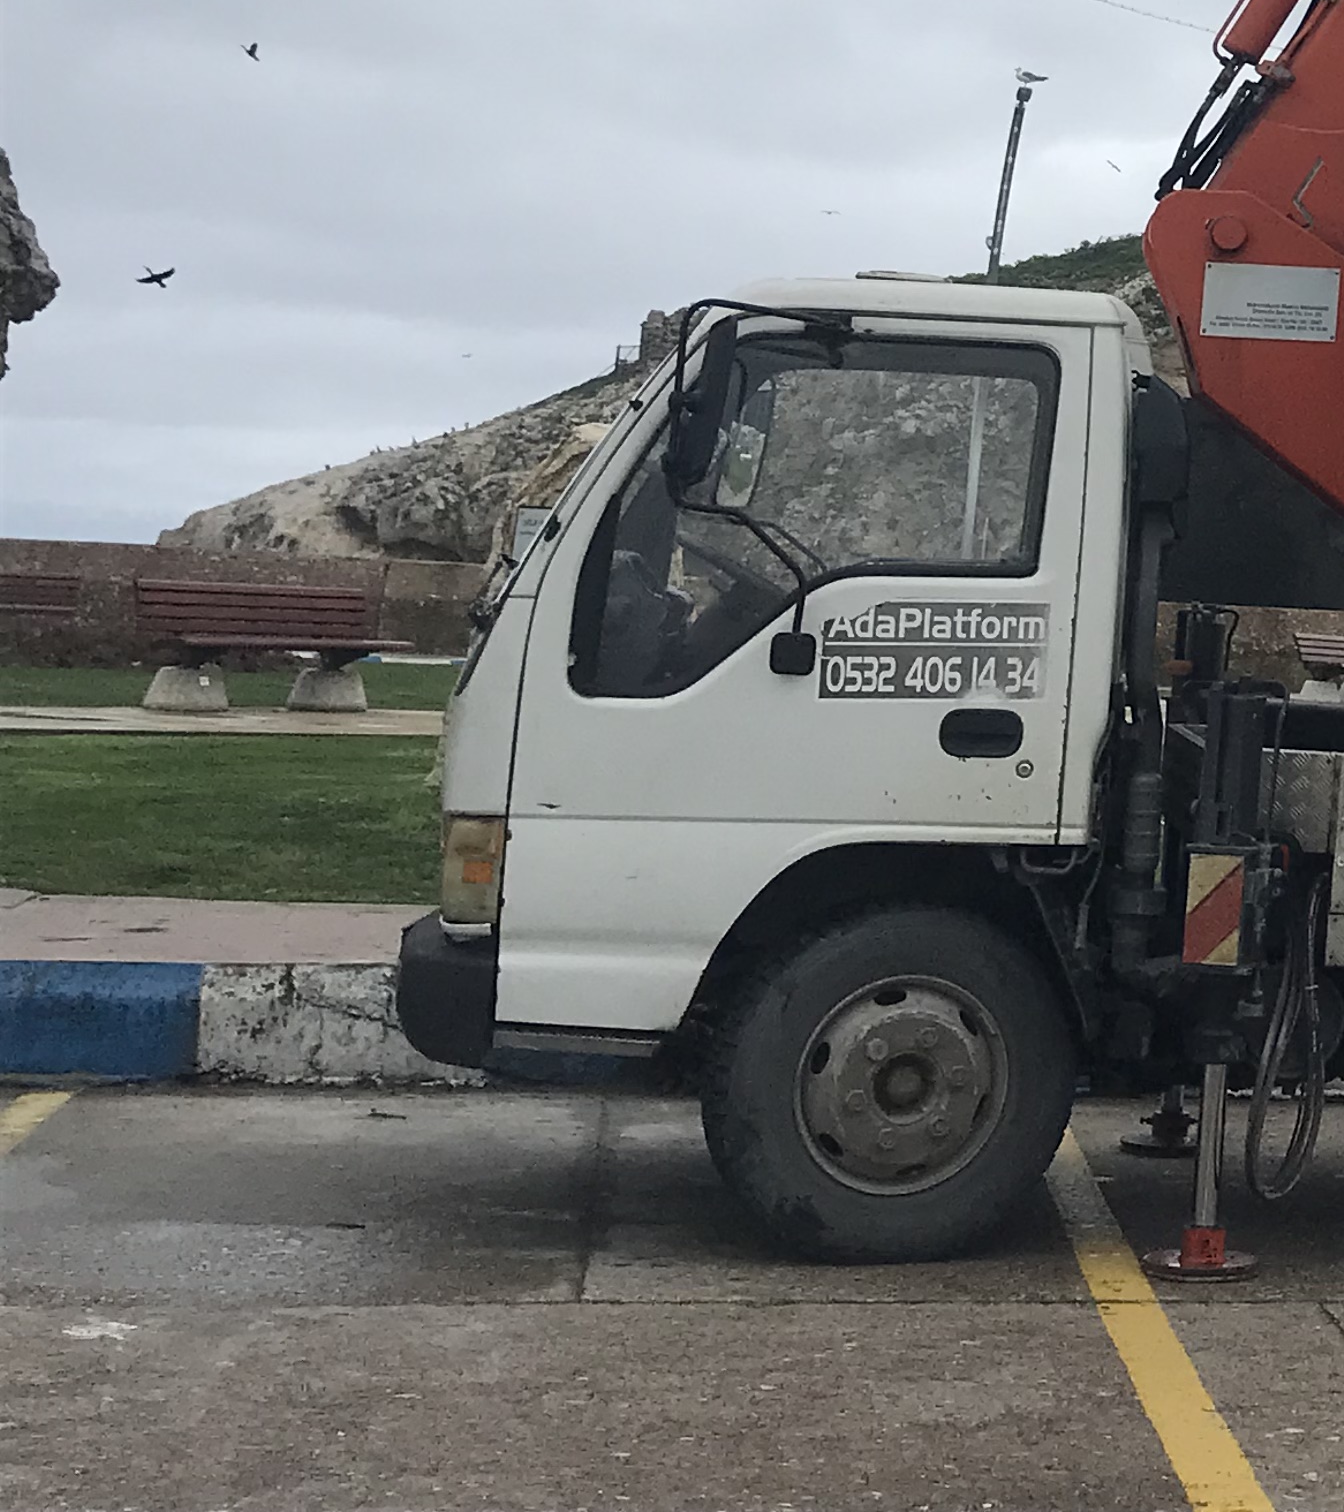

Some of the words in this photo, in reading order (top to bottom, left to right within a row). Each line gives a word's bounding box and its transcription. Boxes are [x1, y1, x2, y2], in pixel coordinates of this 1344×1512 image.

[828, 607, 1046, 639] AdaPlatform
[825, 655, 897, 693] 0532
[904, 656, 963, 694] 406
[970, 656, 997, 691] 14
[1005, 657, 1041, 694] 34
